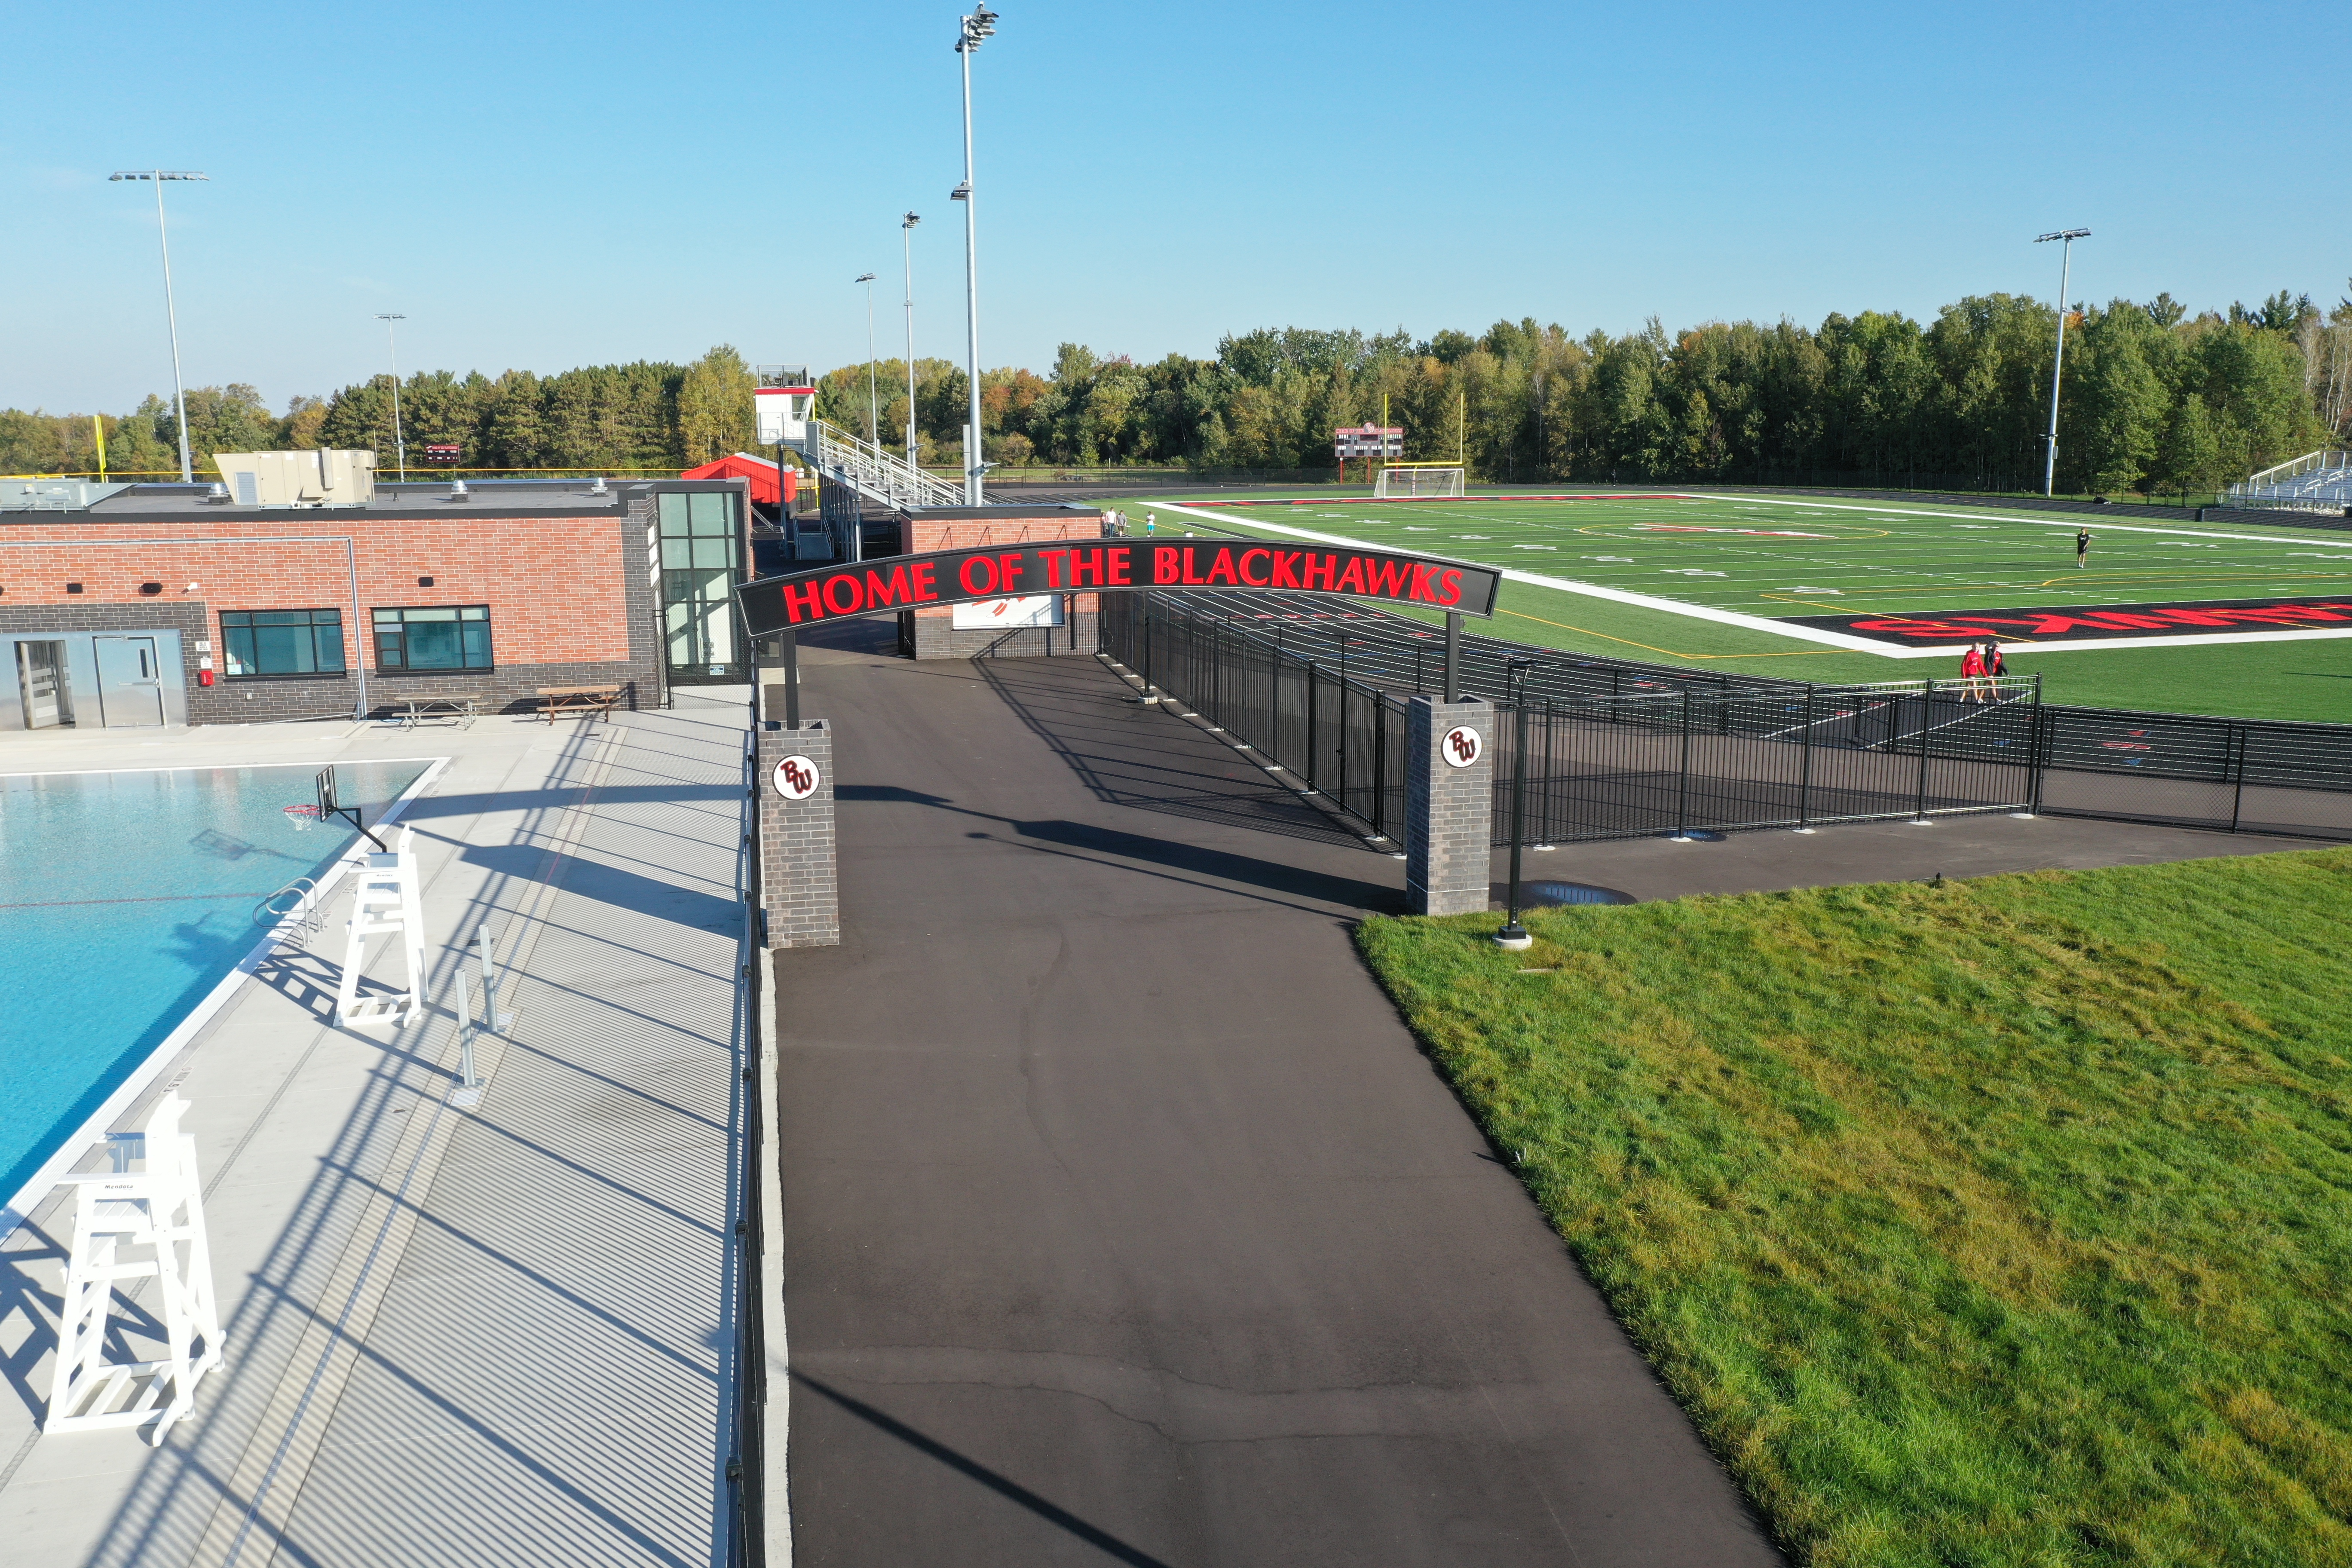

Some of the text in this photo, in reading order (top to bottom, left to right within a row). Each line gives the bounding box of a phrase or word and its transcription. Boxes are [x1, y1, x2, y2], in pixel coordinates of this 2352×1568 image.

[782, 547, 1463, 624] HOME OF THE BLACKHAWKS
[1448, 730, 1476, 762] BW
[779, 760, 813, 794] BW
